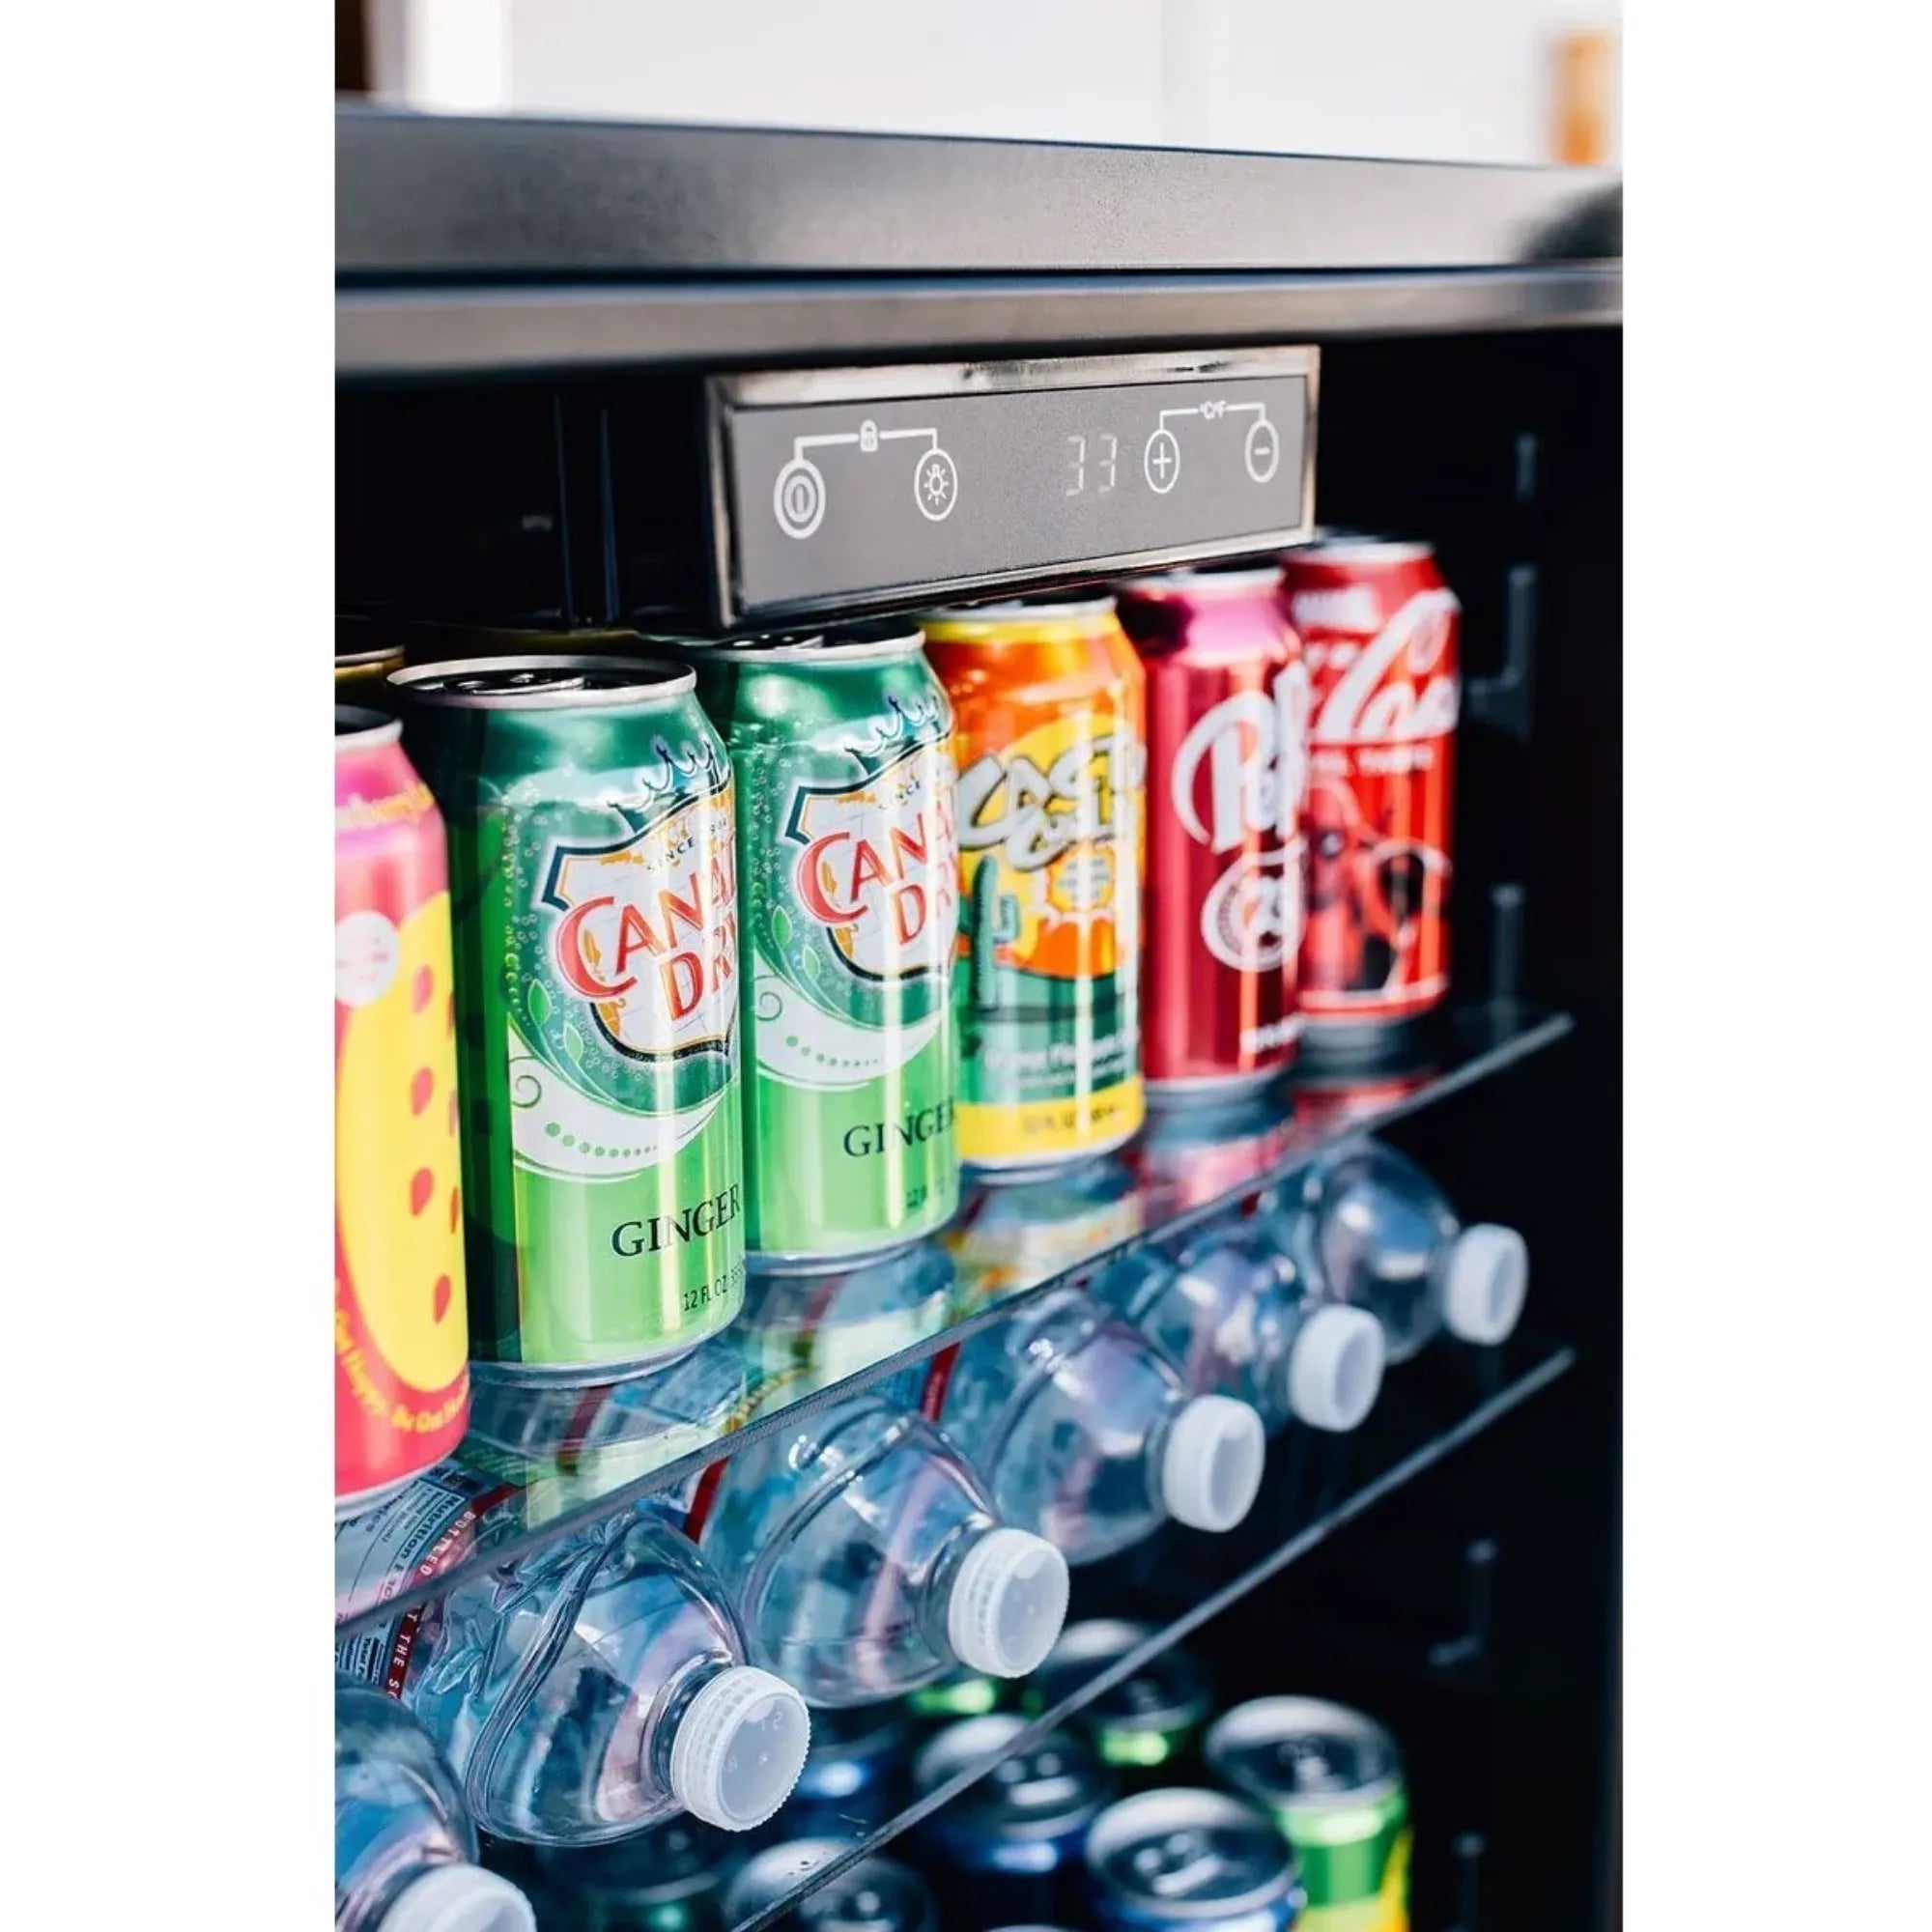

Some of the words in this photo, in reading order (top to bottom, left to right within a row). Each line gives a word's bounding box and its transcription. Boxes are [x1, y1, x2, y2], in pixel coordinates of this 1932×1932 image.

[1065, 433, 1118, 497] 33
[611, 1183, 740, 1256] GINGER
[684, 1290, 697, 1311] 12
[401, 1495, 461, 1559] Nutrition
[419, 1510, 476, 1576] BOTTLED
[393, 1634, 412, 1668] THE
